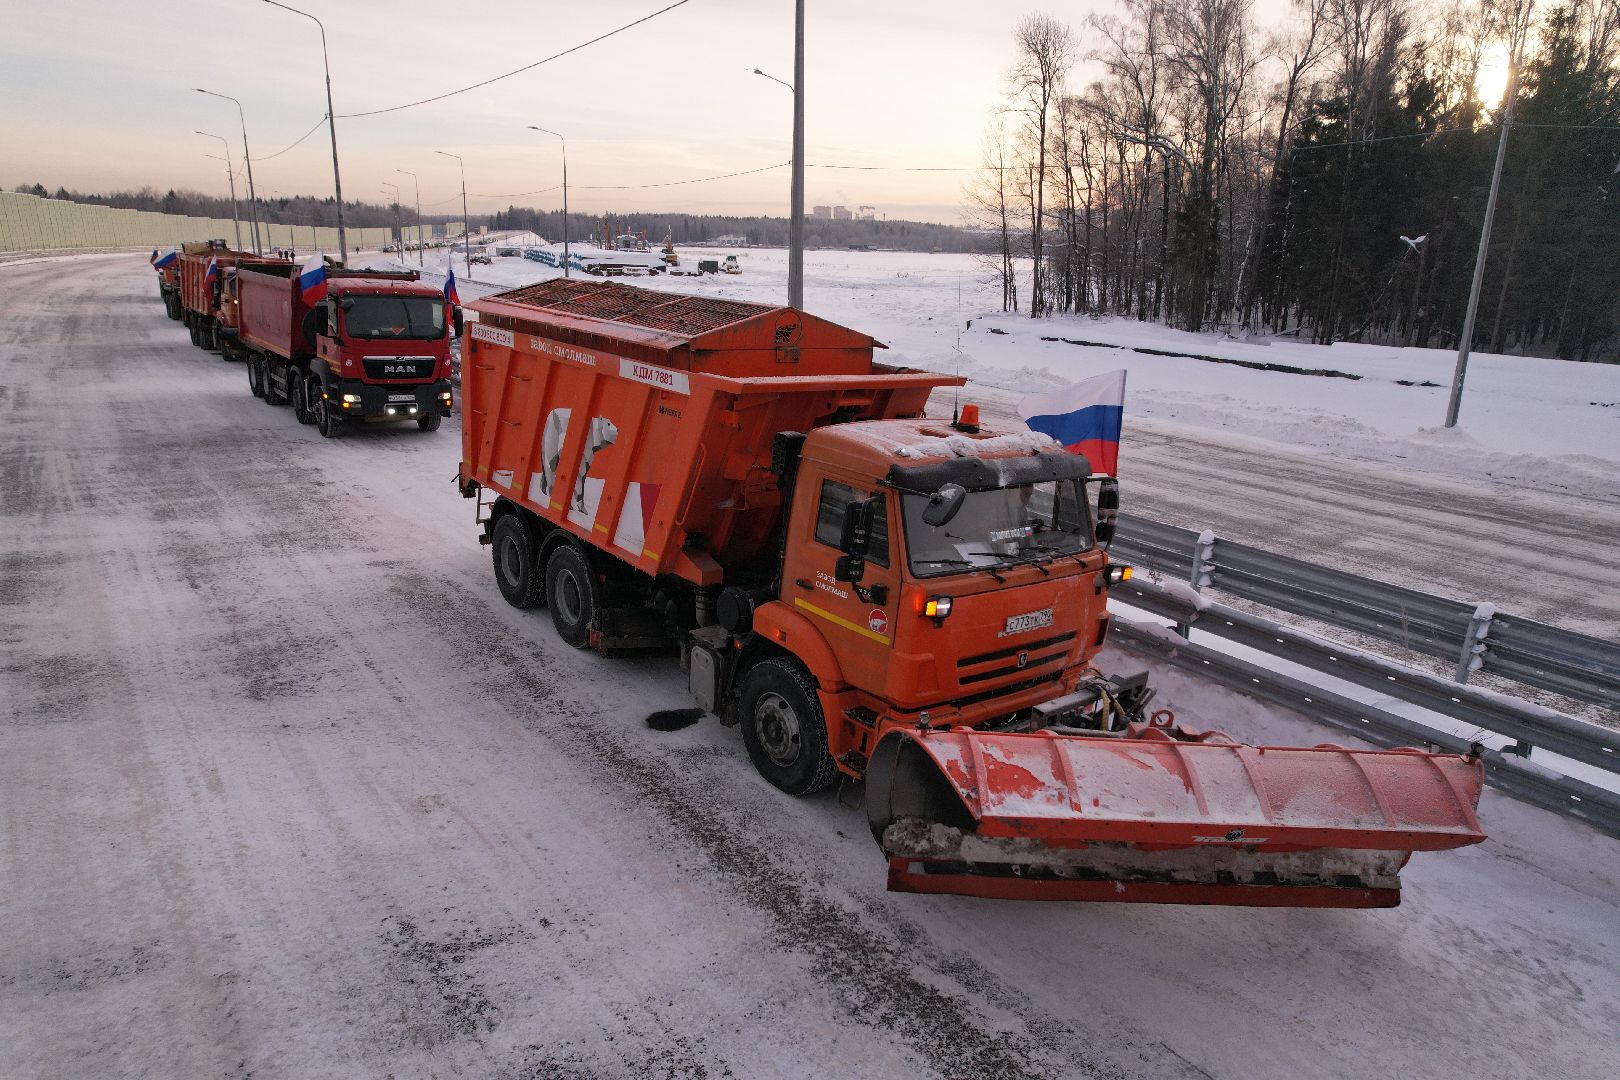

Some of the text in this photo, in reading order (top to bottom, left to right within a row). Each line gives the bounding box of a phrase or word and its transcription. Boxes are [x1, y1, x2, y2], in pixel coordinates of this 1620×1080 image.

[384, 365, 417, 373] MAN
[632, 364, 674, 386] КДМ 7881
